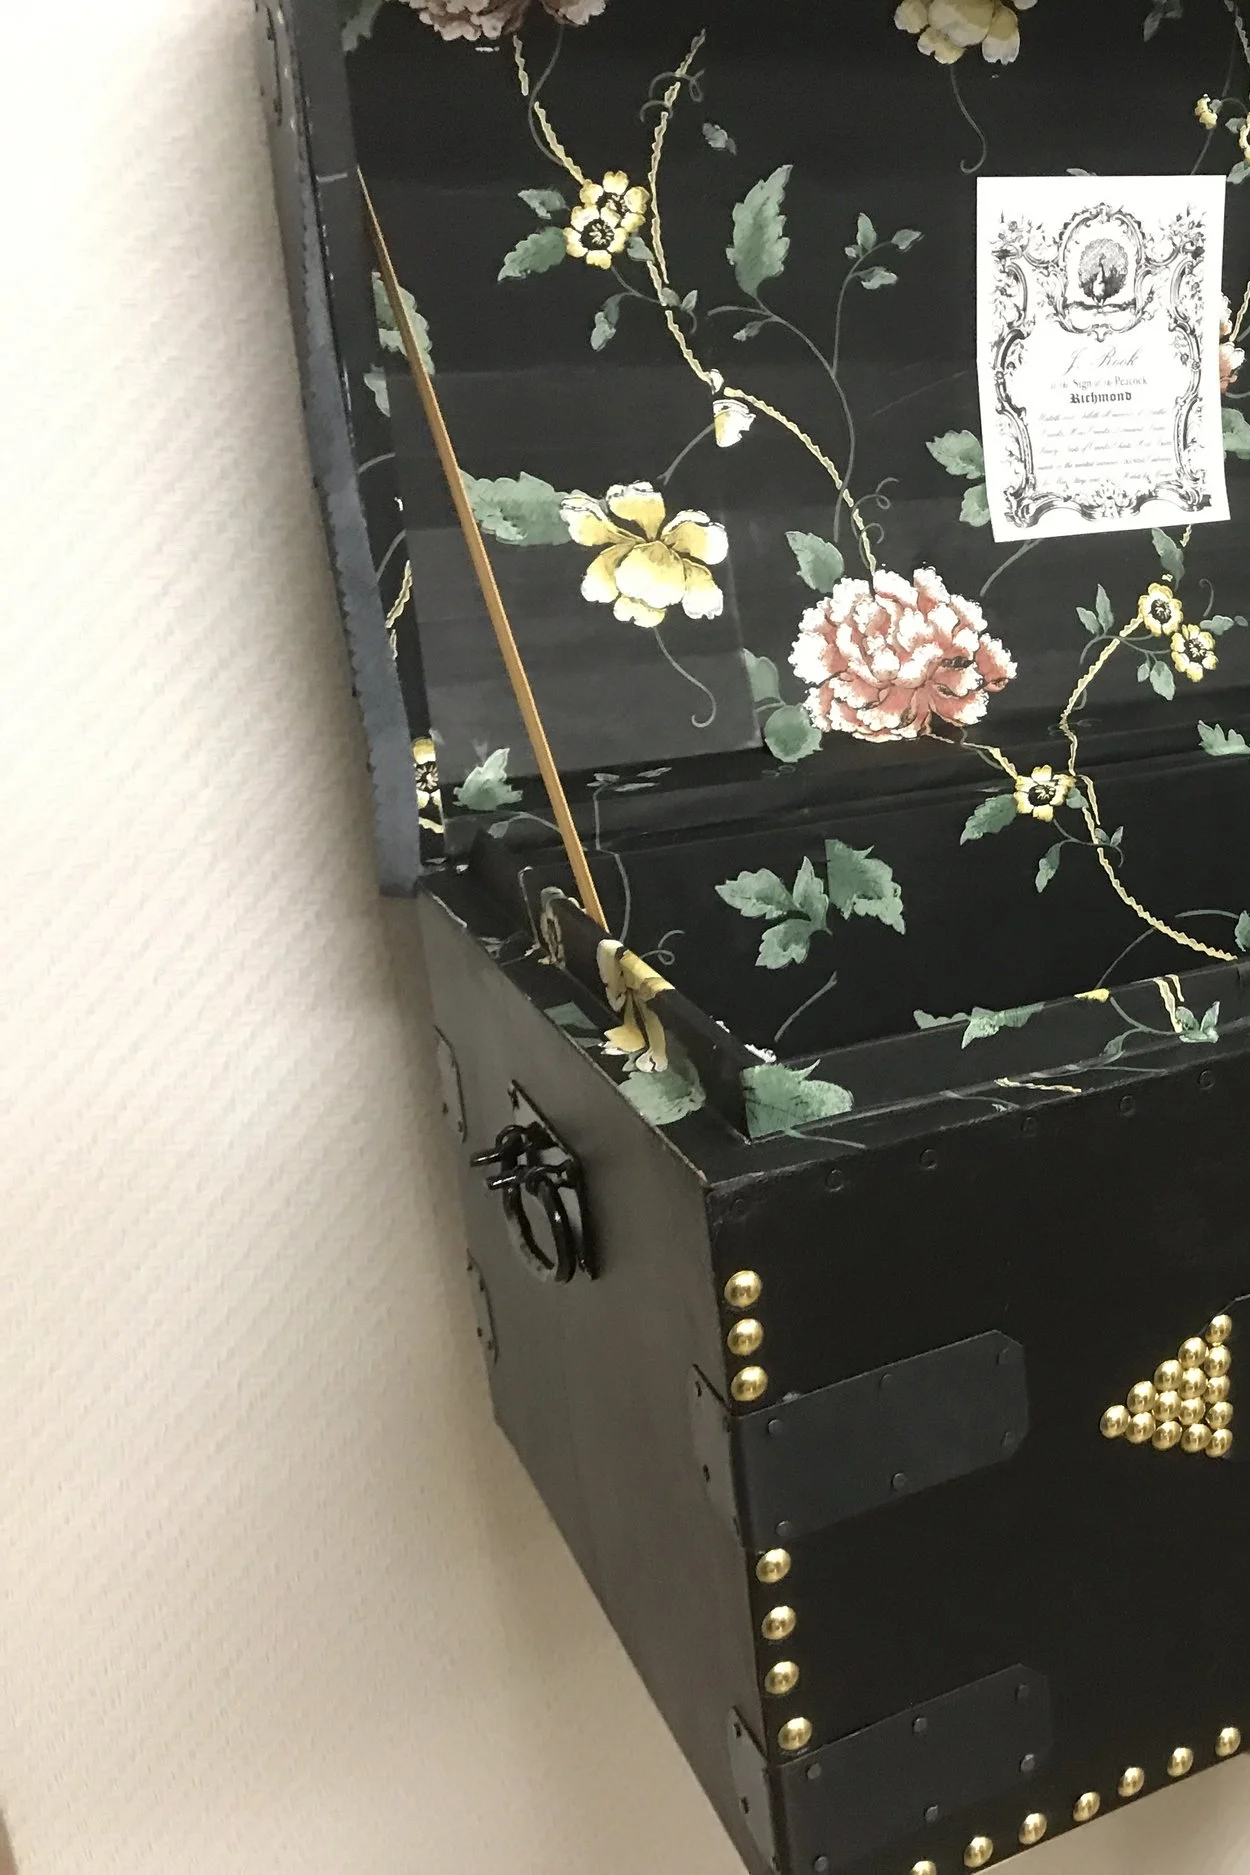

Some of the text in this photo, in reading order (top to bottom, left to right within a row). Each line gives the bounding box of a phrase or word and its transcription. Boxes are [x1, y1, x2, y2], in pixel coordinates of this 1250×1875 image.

[1072, 379, 1092, 391] Sign
[1115, 376, 1148, 386] Peacock
[1069, 391, 1132, 405] Richmond
